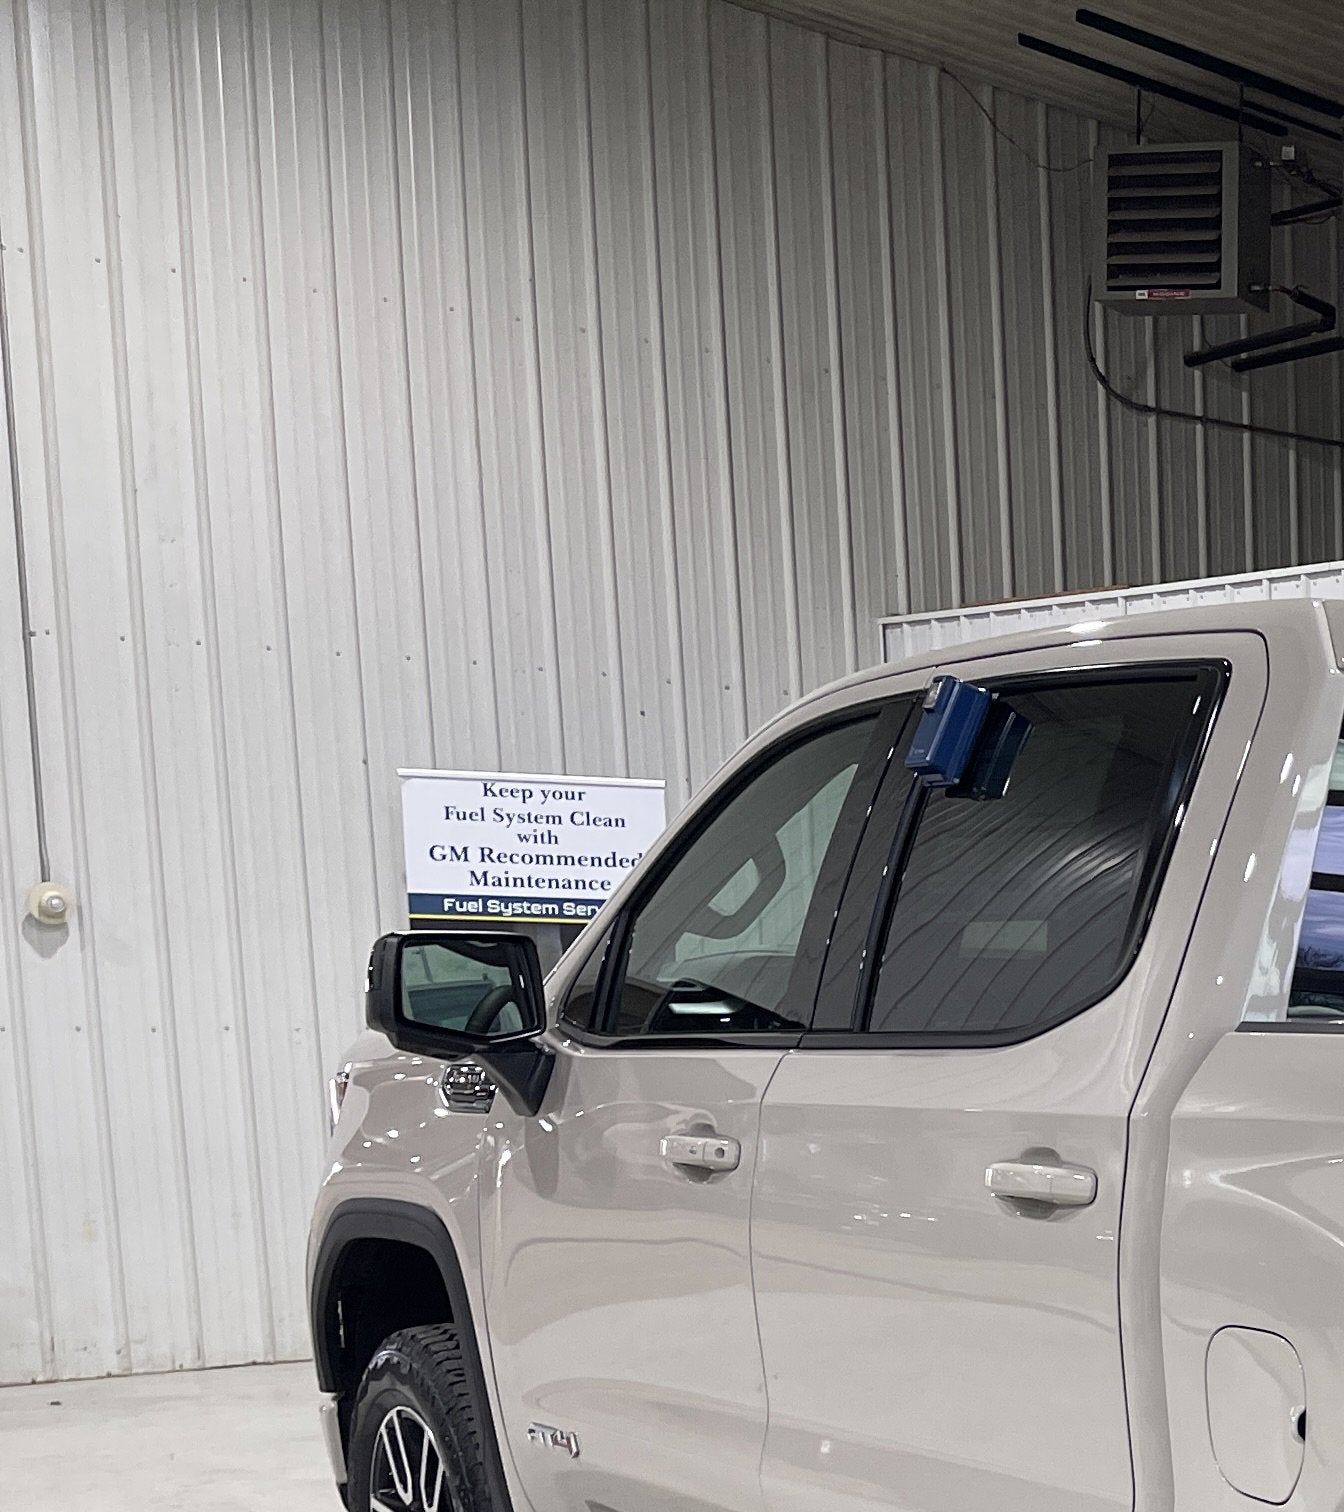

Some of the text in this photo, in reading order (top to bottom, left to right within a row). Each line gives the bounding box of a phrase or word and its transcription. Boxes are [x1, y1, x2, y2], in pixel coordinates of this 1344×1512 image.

[483, 782, 586, 805] Keep your
[444, 806, 626, 828] Fuel System Clean
[516, 829, 559, 845] with
[429, 845, 470, 862] GM
[469, 870, 612, 892] Maintenance
[443, 898, 601, 917] Fuel System Ser
[527, 1421, 580, 1459] AT4
